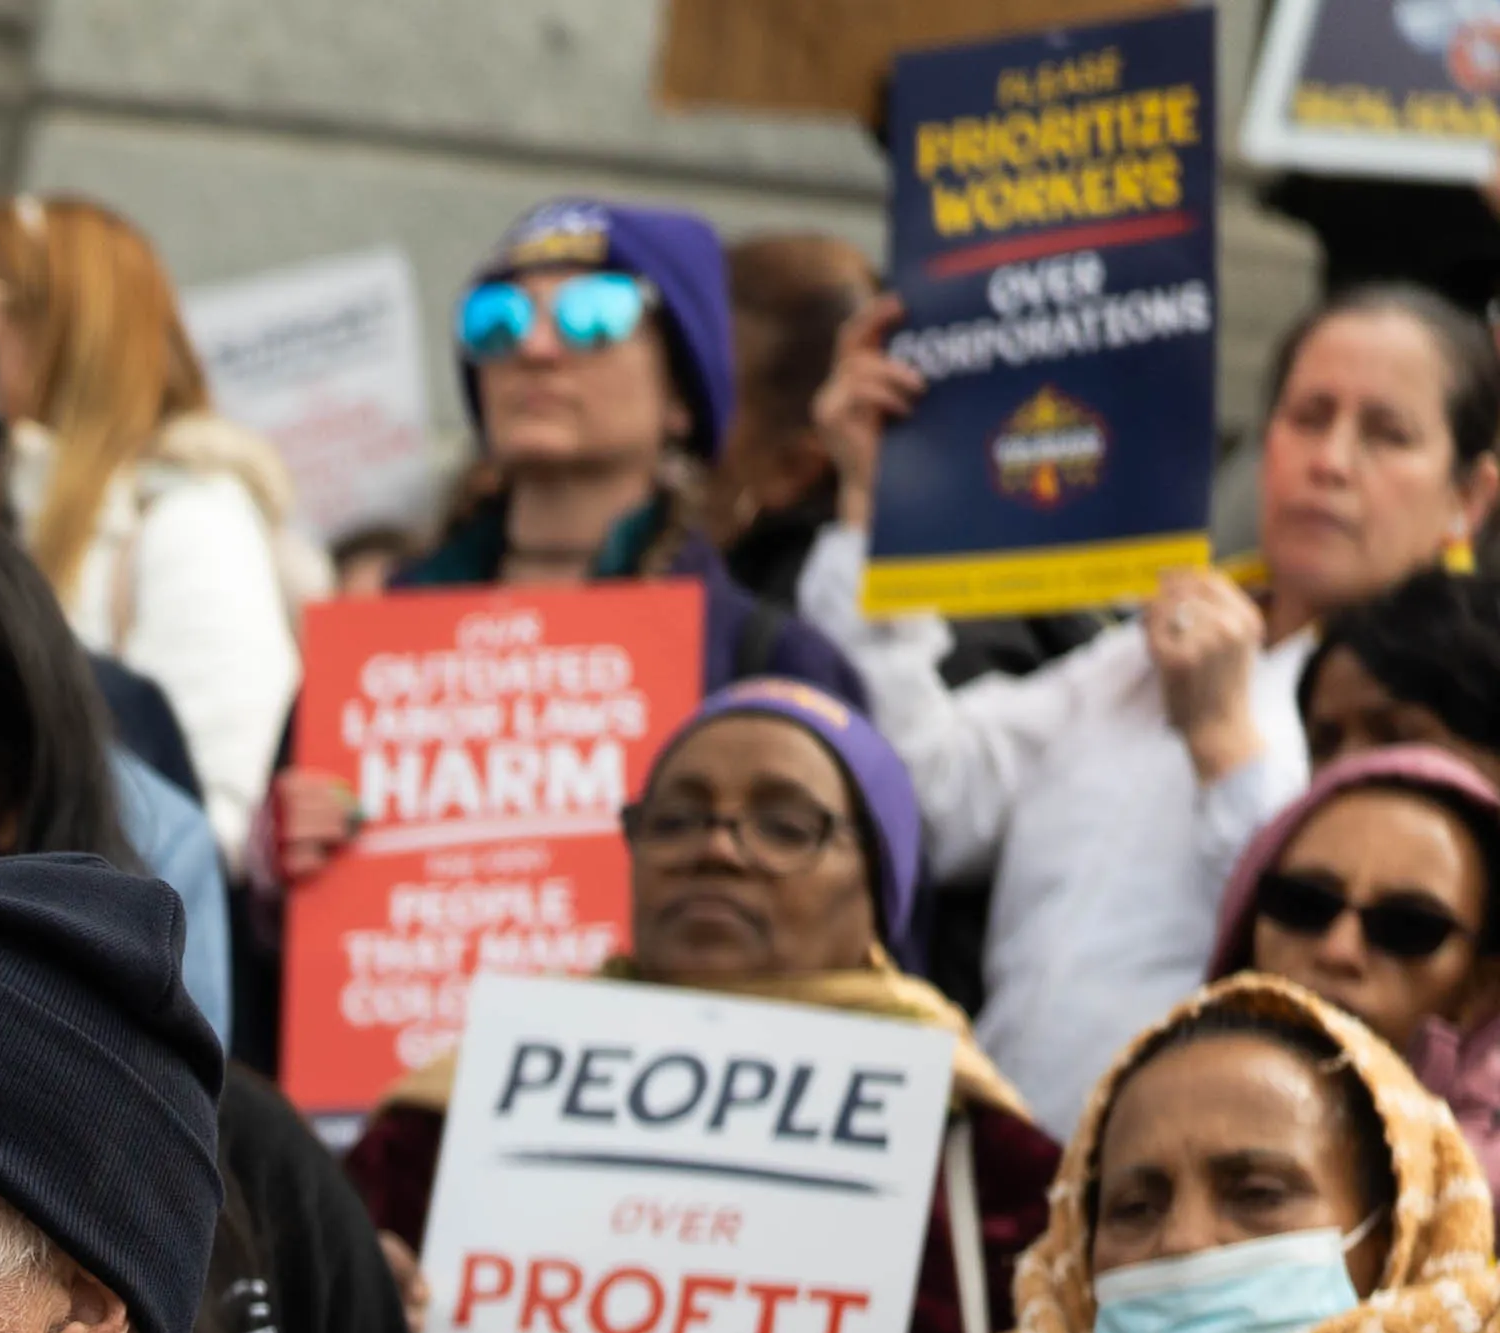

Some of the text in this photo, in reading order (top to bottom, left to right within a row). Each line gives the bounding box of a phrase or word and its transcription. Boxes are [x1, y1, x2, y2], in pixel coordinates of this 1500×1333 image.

[915, 83, 1200, 183] PRIORITIZE
[933, 152, 1183, 236] WORKERS
[989, 250, 1106, 315] OVER
[888, 280, 1212, 379] CORPORATIONS
[361, 643, 633, 701] OUTDATED
[341, 690, 648, 750] LABOR LAWS
[361, 736, 628, 821] HARM
[389, 877, 575, 930] PEOPLE
[342, 928, 464, 977] THAT
[495, 1041, 906, 1153] PEOPLE
[611, 1199, 744, 1245] OVER
